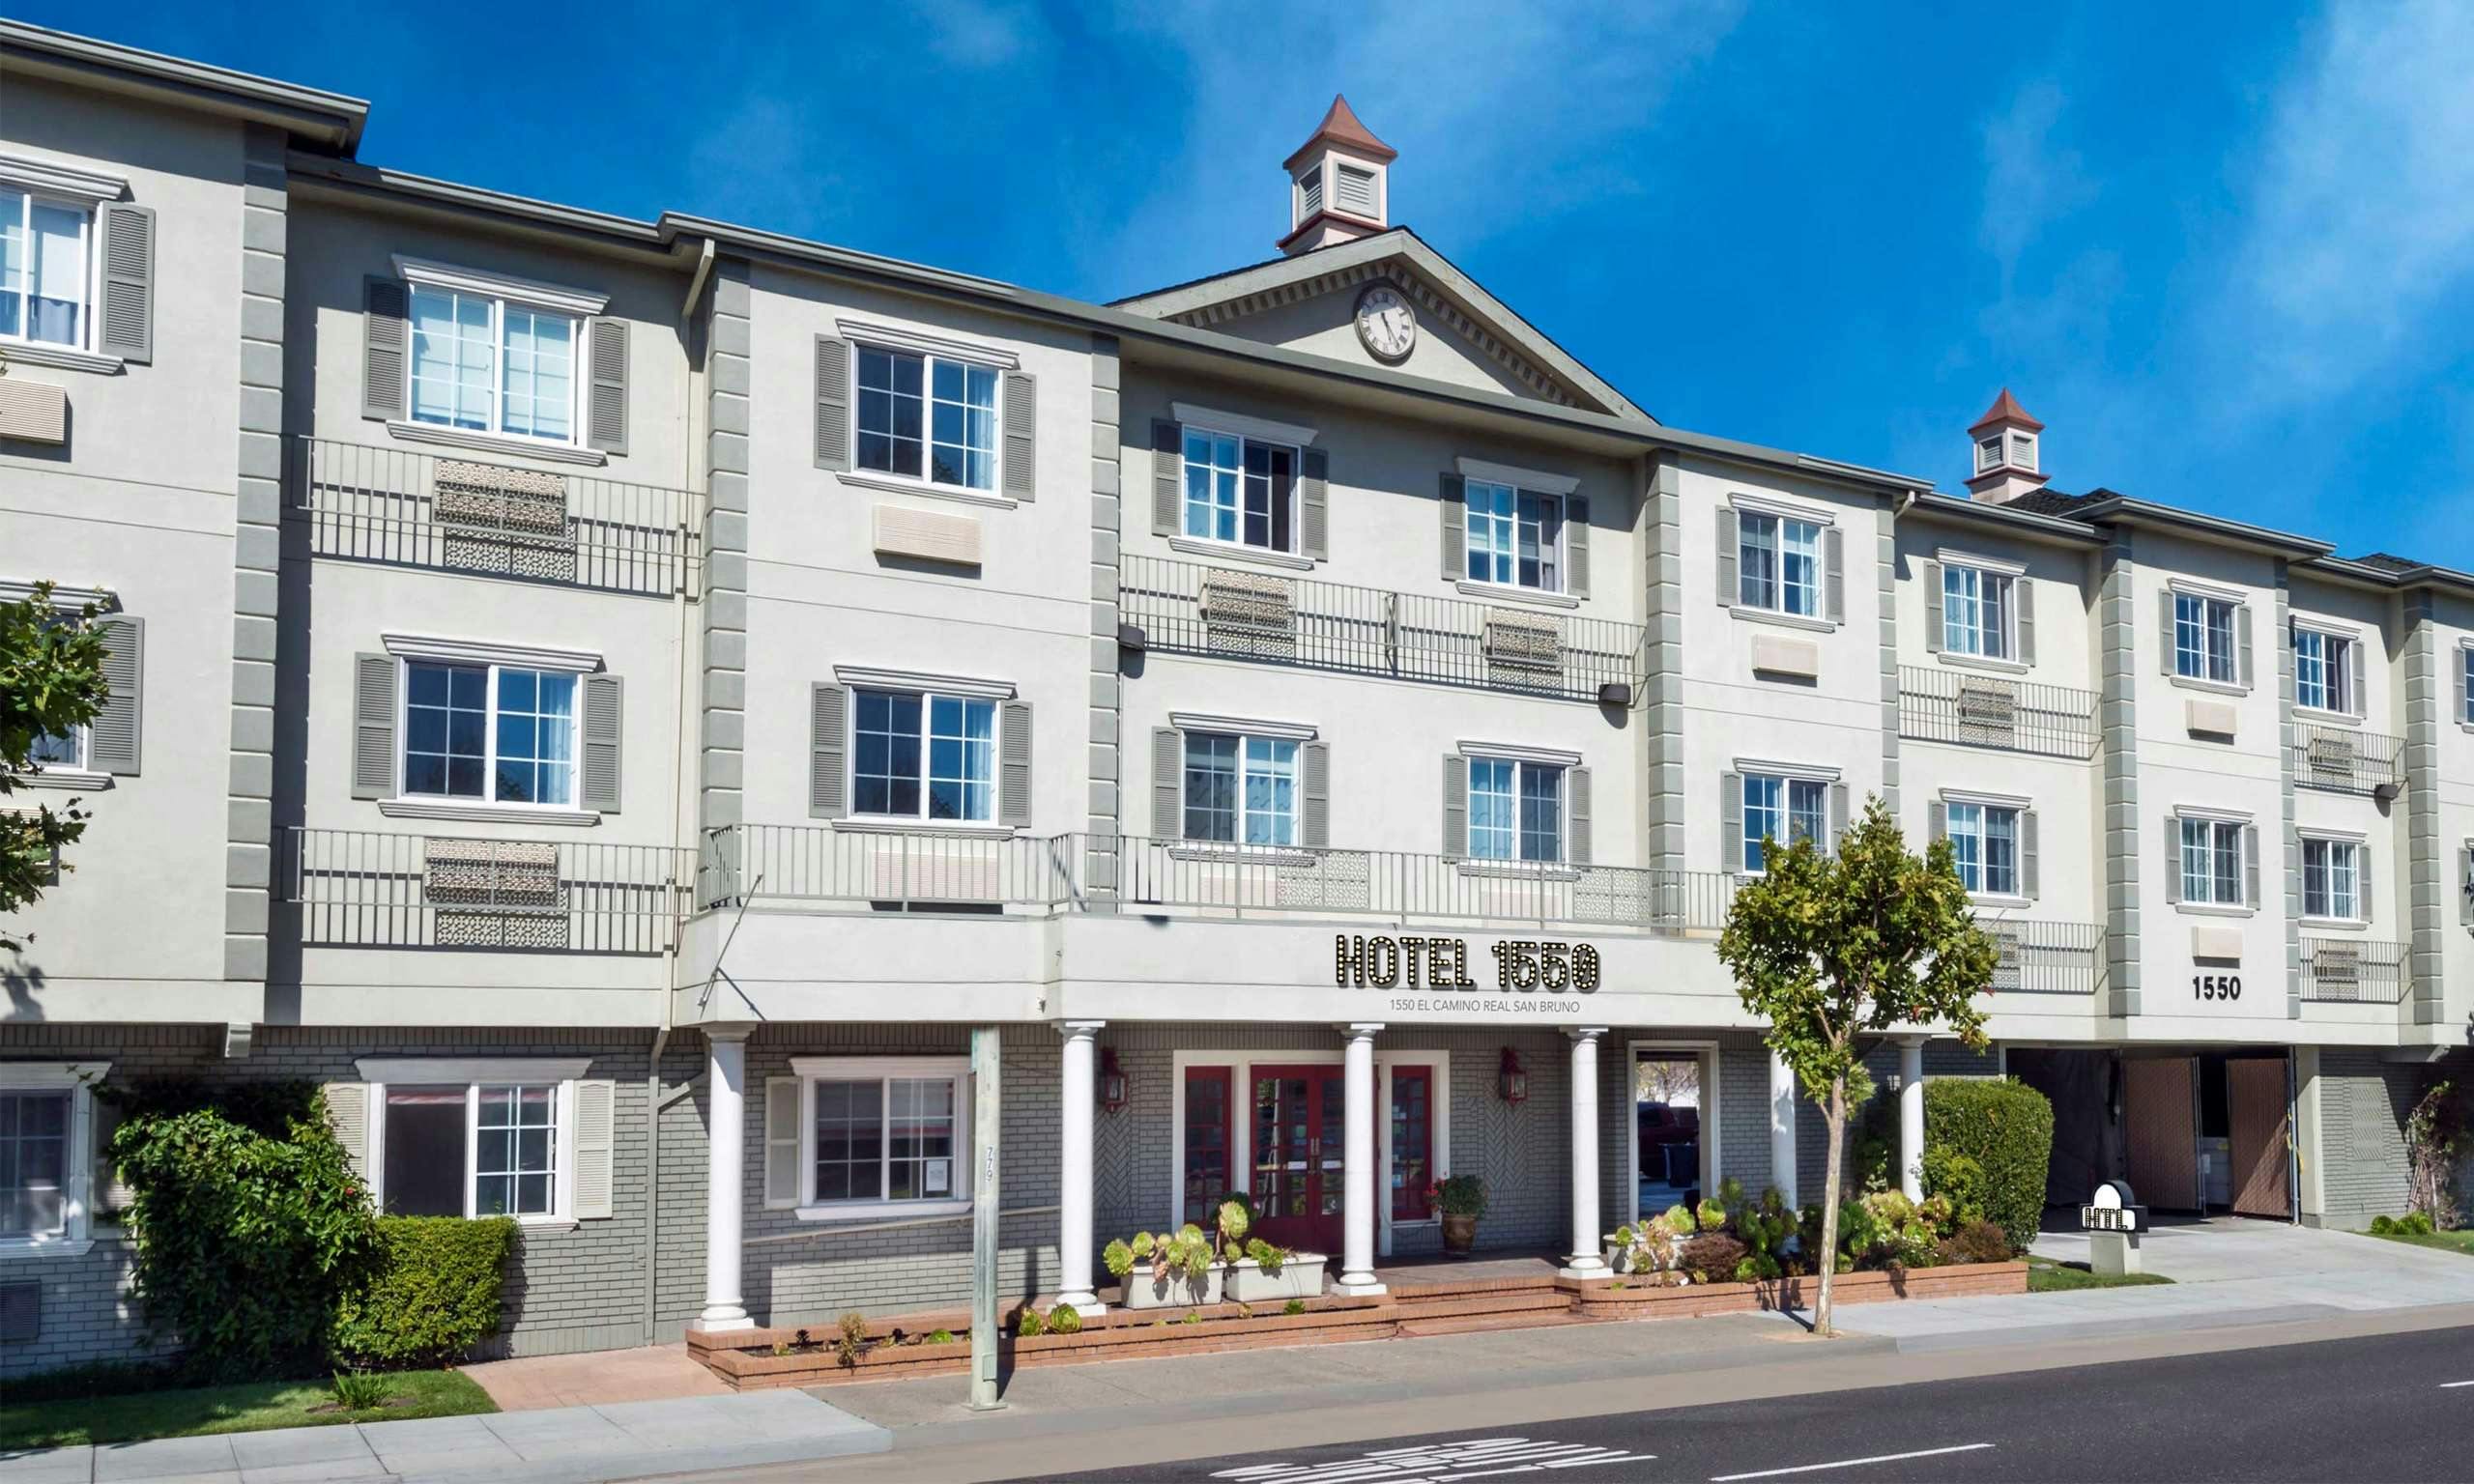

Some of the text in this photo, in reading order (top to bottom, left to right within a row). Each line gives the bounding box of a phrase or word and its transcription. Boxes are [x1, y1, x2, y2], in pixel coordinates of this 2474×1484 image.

[1336, 934, 1597, 990] HOTEL 1550
[2192, 976, 2241, 1001] 1550
[1390, 999, 1580, 1013] 1550 EL CAMINO REAL SAN BRUNO
